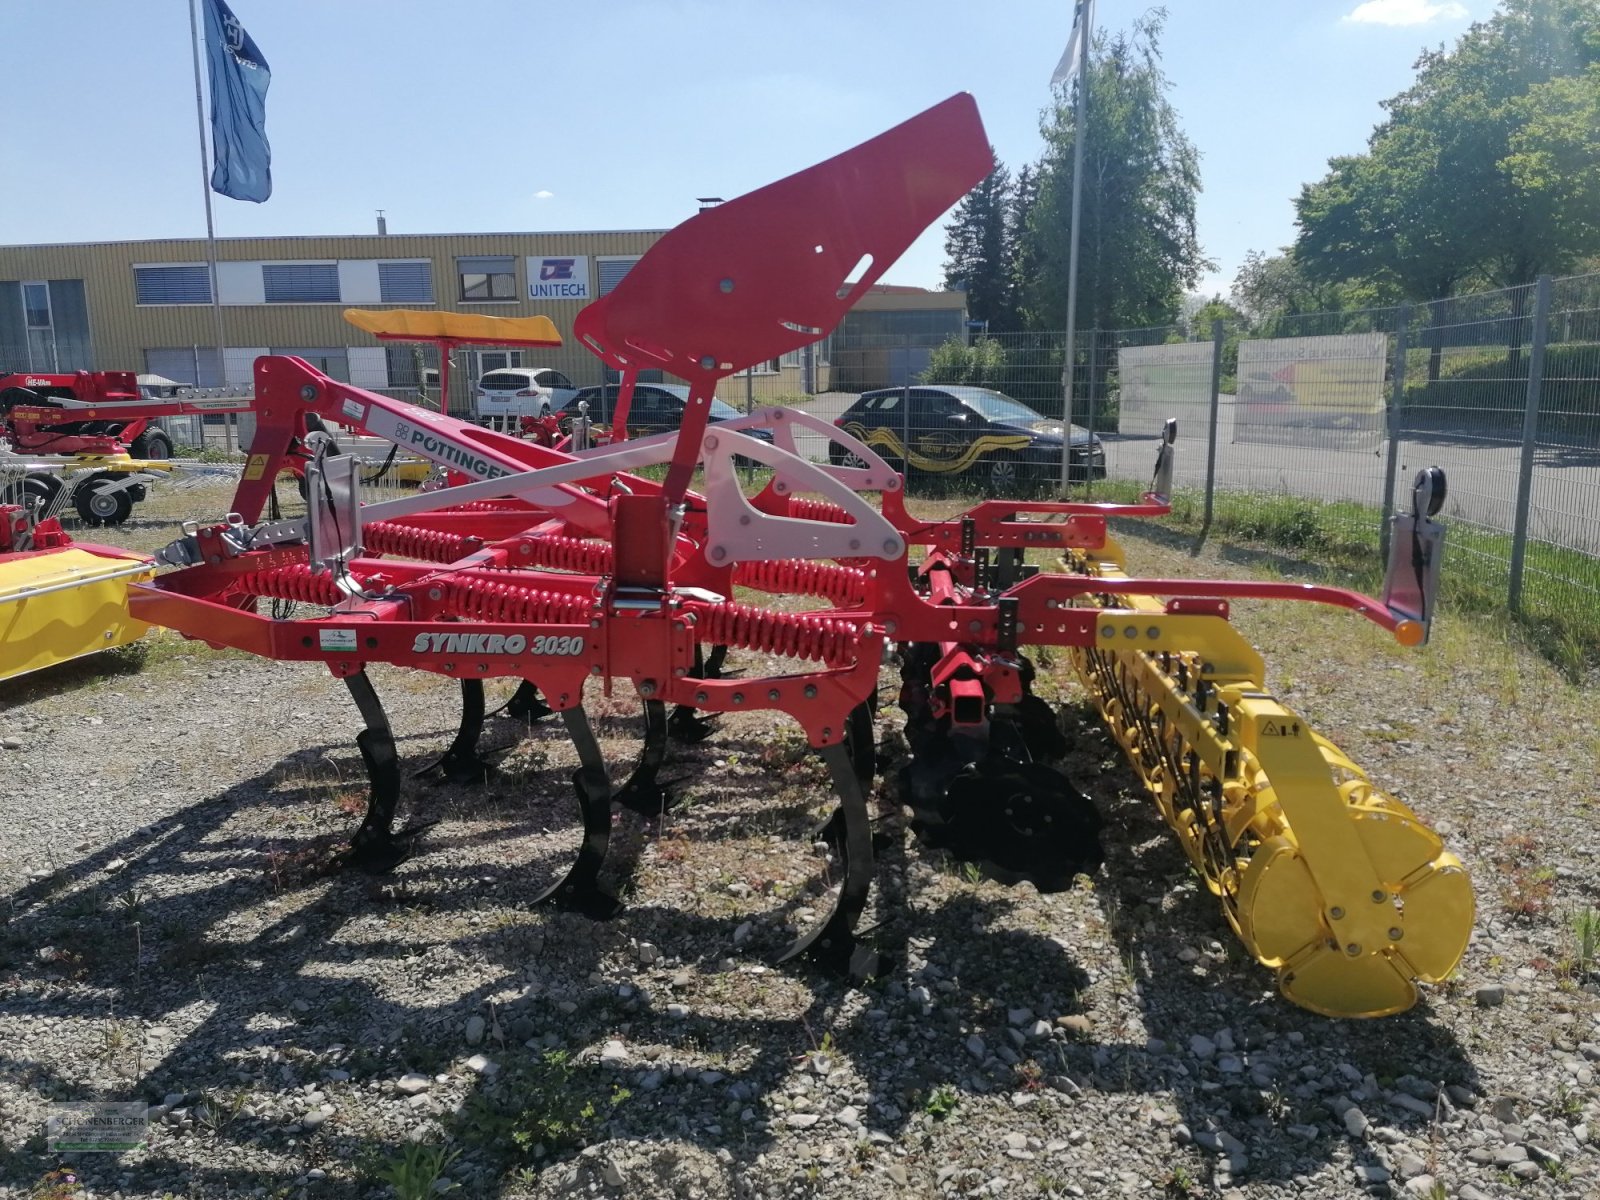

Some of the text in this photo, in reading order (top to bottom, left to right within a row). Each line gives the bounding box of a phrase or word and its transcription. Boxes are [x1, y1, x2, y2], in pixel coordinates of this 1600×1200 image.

[530, 284, 586, 297] UNITECH
[412, 632, 584, 656] SYNKRO 3030
